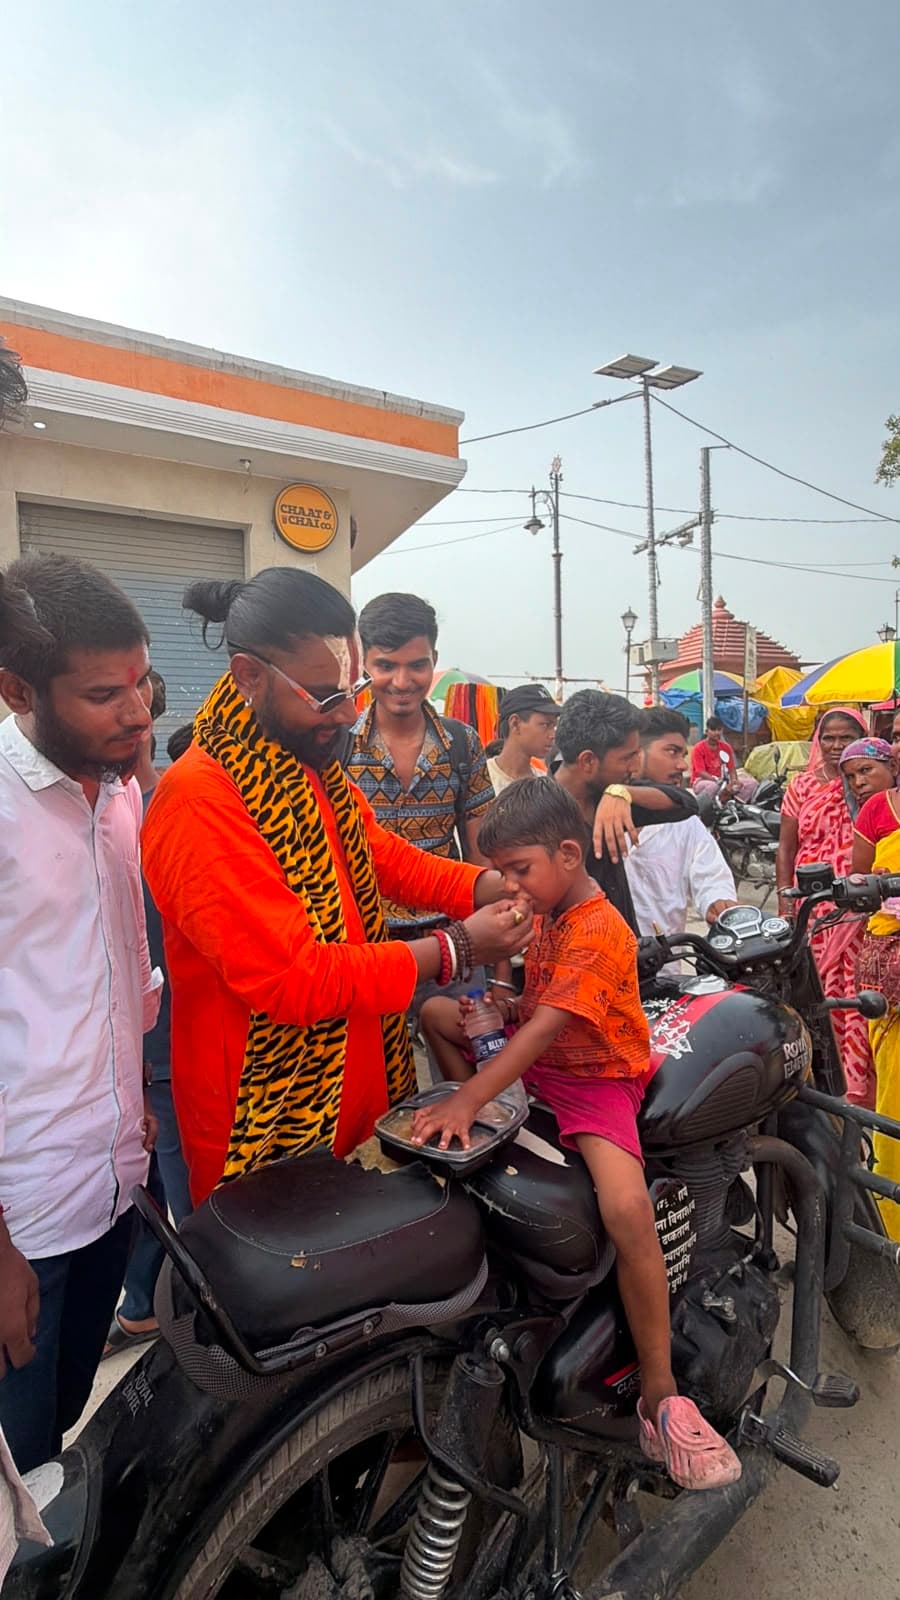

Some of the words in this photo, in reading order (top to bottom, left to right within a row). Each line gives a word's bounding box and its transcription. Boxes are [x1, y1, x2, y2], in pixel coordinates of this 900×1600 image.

[288, 515, 320, 529] CHAI
[783, 1039, 808, 1060] ROYA
[784, 1053, 809, 1080] ENFIE
[135, 1370, 155, 1408] ROYAL
